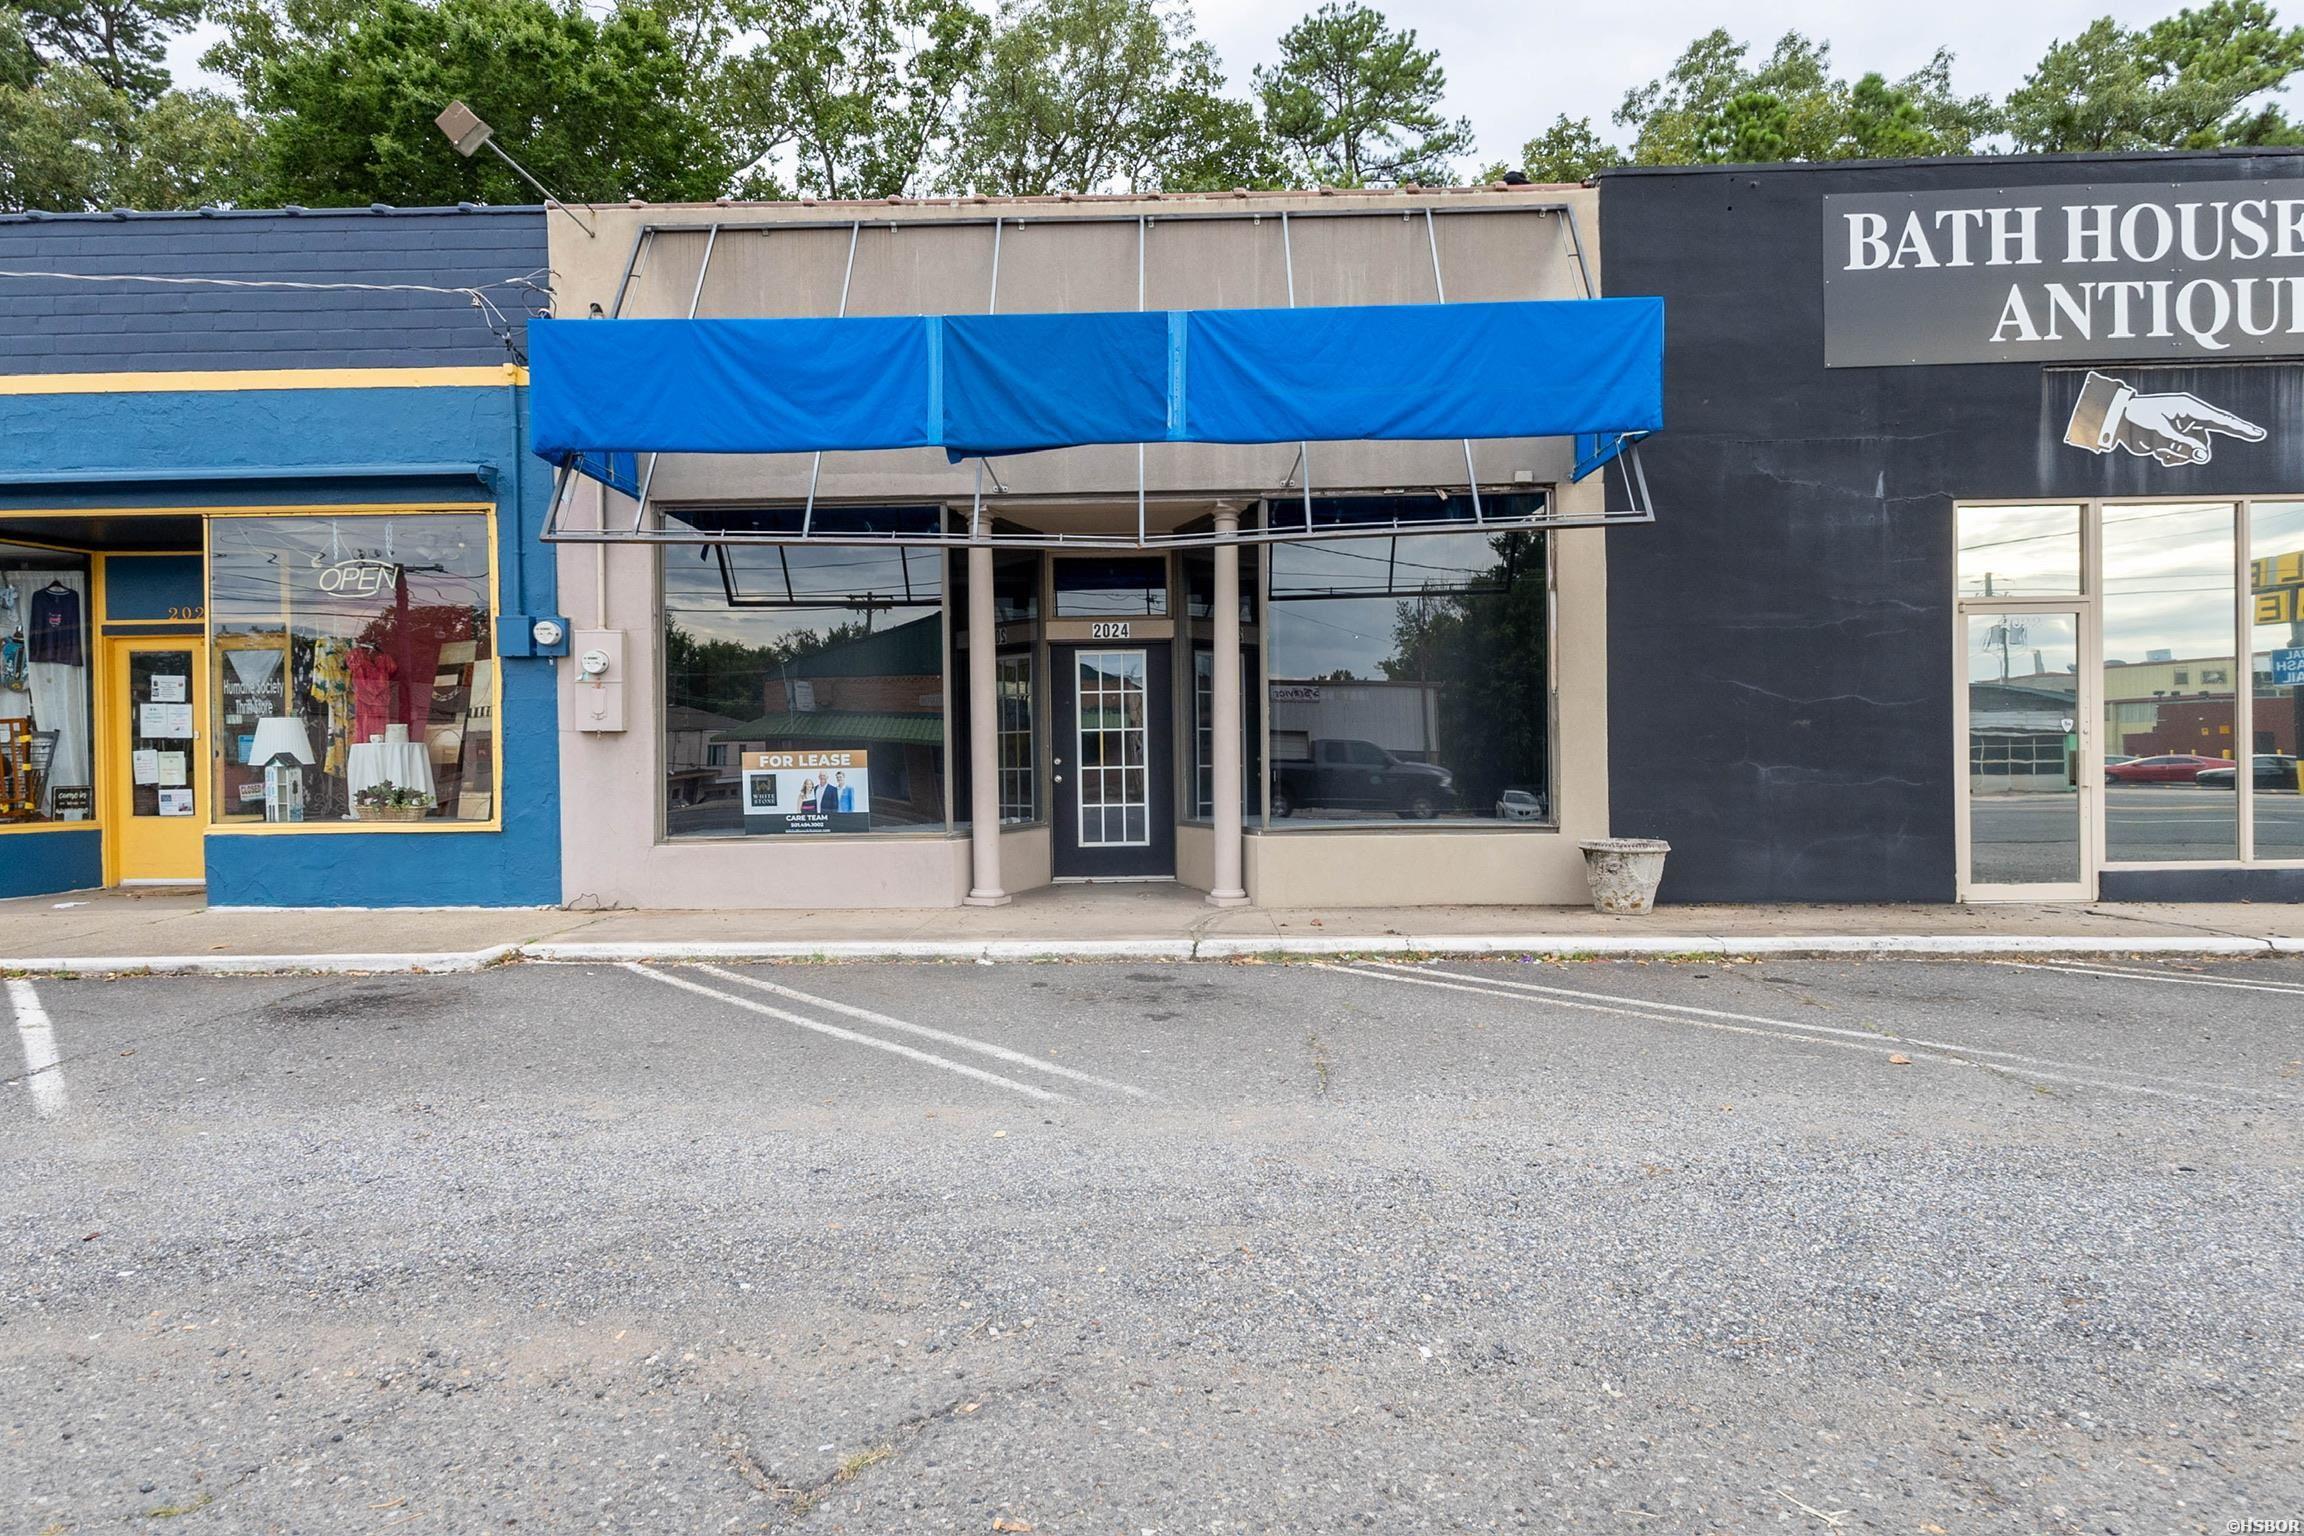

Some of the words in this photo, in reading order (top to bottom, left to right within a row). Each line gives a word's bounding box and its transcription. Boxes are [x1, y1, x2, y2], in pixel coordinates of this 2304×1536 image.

[1843, 206, 2042, 270] BATH
[2061, 199, 2304, 263] HOUSE
[320, 567, 398, 591] OPEN
[1093, 623, 1129, 638] 2024
[760, 755, 793, 767] FOR
[799, 754, 851, 766] LEASE
